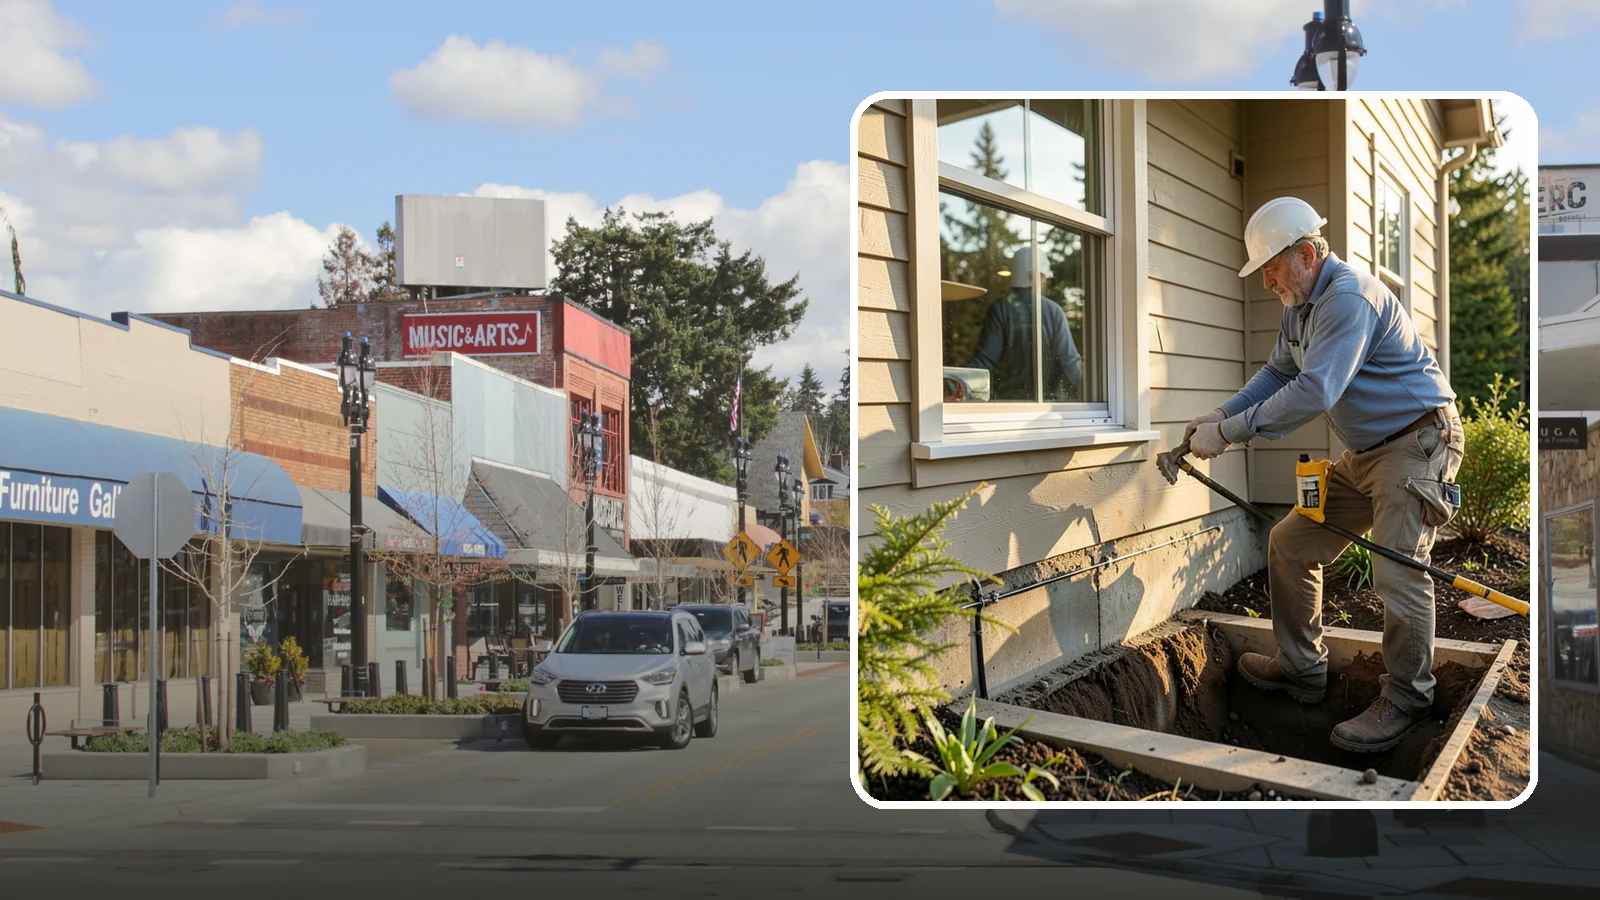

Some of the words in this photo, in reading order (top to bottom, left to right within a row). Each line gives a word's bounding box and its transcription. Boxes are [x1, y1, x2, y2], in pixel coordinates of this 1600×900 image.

[409, 323, 519, 349] MUSIC&ARTS
[0, 472, 79, 515] Furniture
[90, 483, 121, 519] Gal
[453, 563, 479, 574] SUSHI
